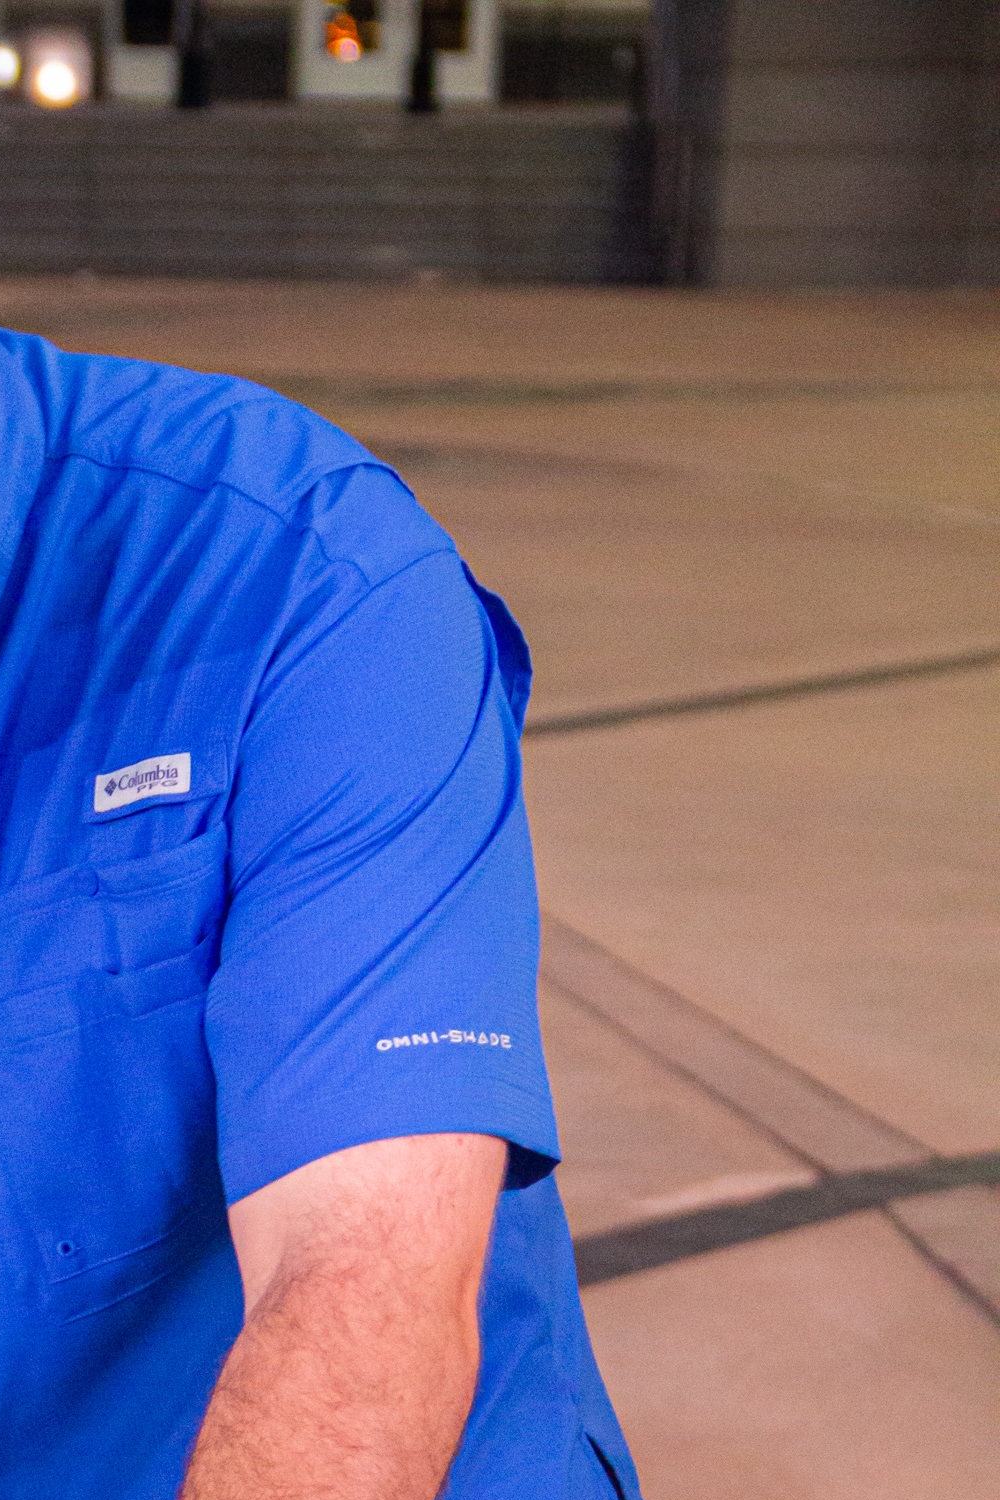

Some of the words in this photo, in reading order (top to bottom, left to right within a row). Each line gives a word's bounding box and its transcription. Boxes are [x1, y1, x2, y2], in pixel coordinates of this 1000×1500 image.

[118, 763, 178, 790] Columbia
[136, 780, 178, 793] PFG
[376, 1029, 512, 1051] OMNI-SHADE
